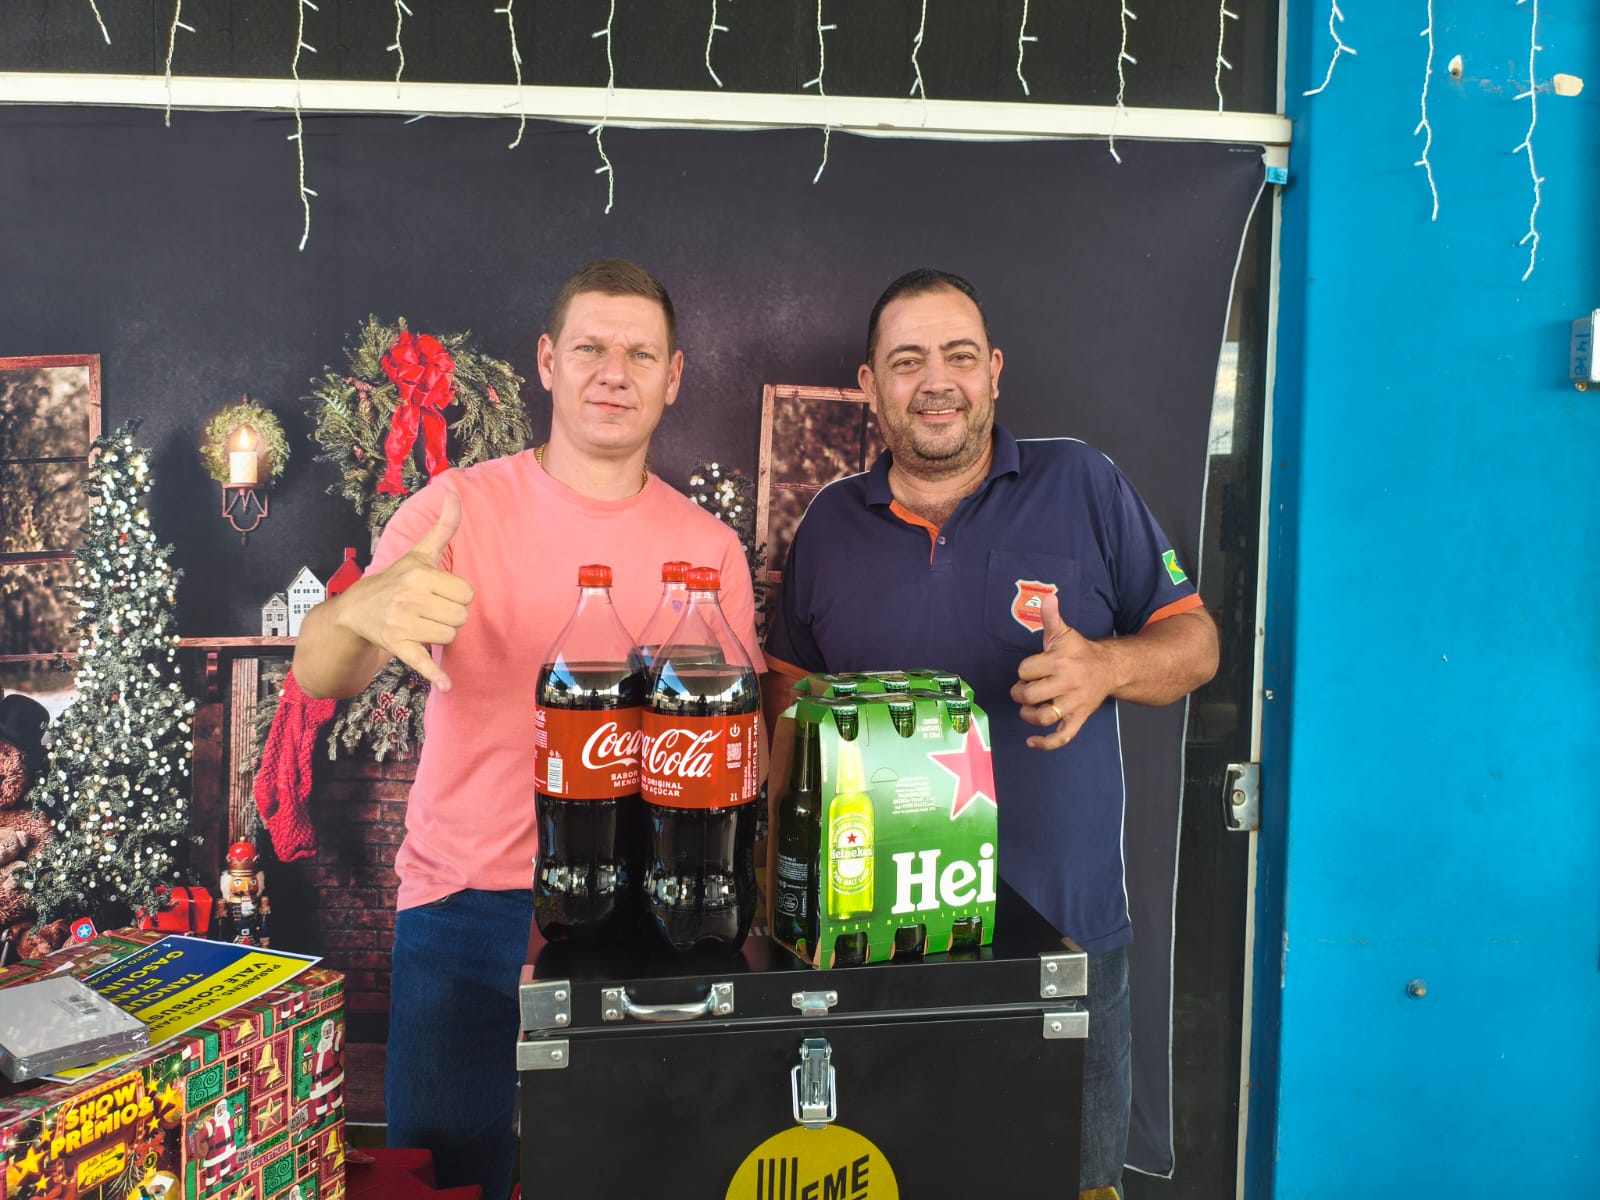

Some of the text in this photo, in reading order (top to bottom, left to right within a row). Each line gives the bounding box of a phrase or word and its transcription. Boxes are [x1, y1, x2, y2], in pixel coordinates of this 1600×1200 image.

[610, 769, 639, 781] SABOR
[647, 777, 683, 790] ORIGINAL
[891, 842, 996, 915] Hei
[223, 961, 268, 984] VALE
[64, 1081, 137, 1130] SHOW
